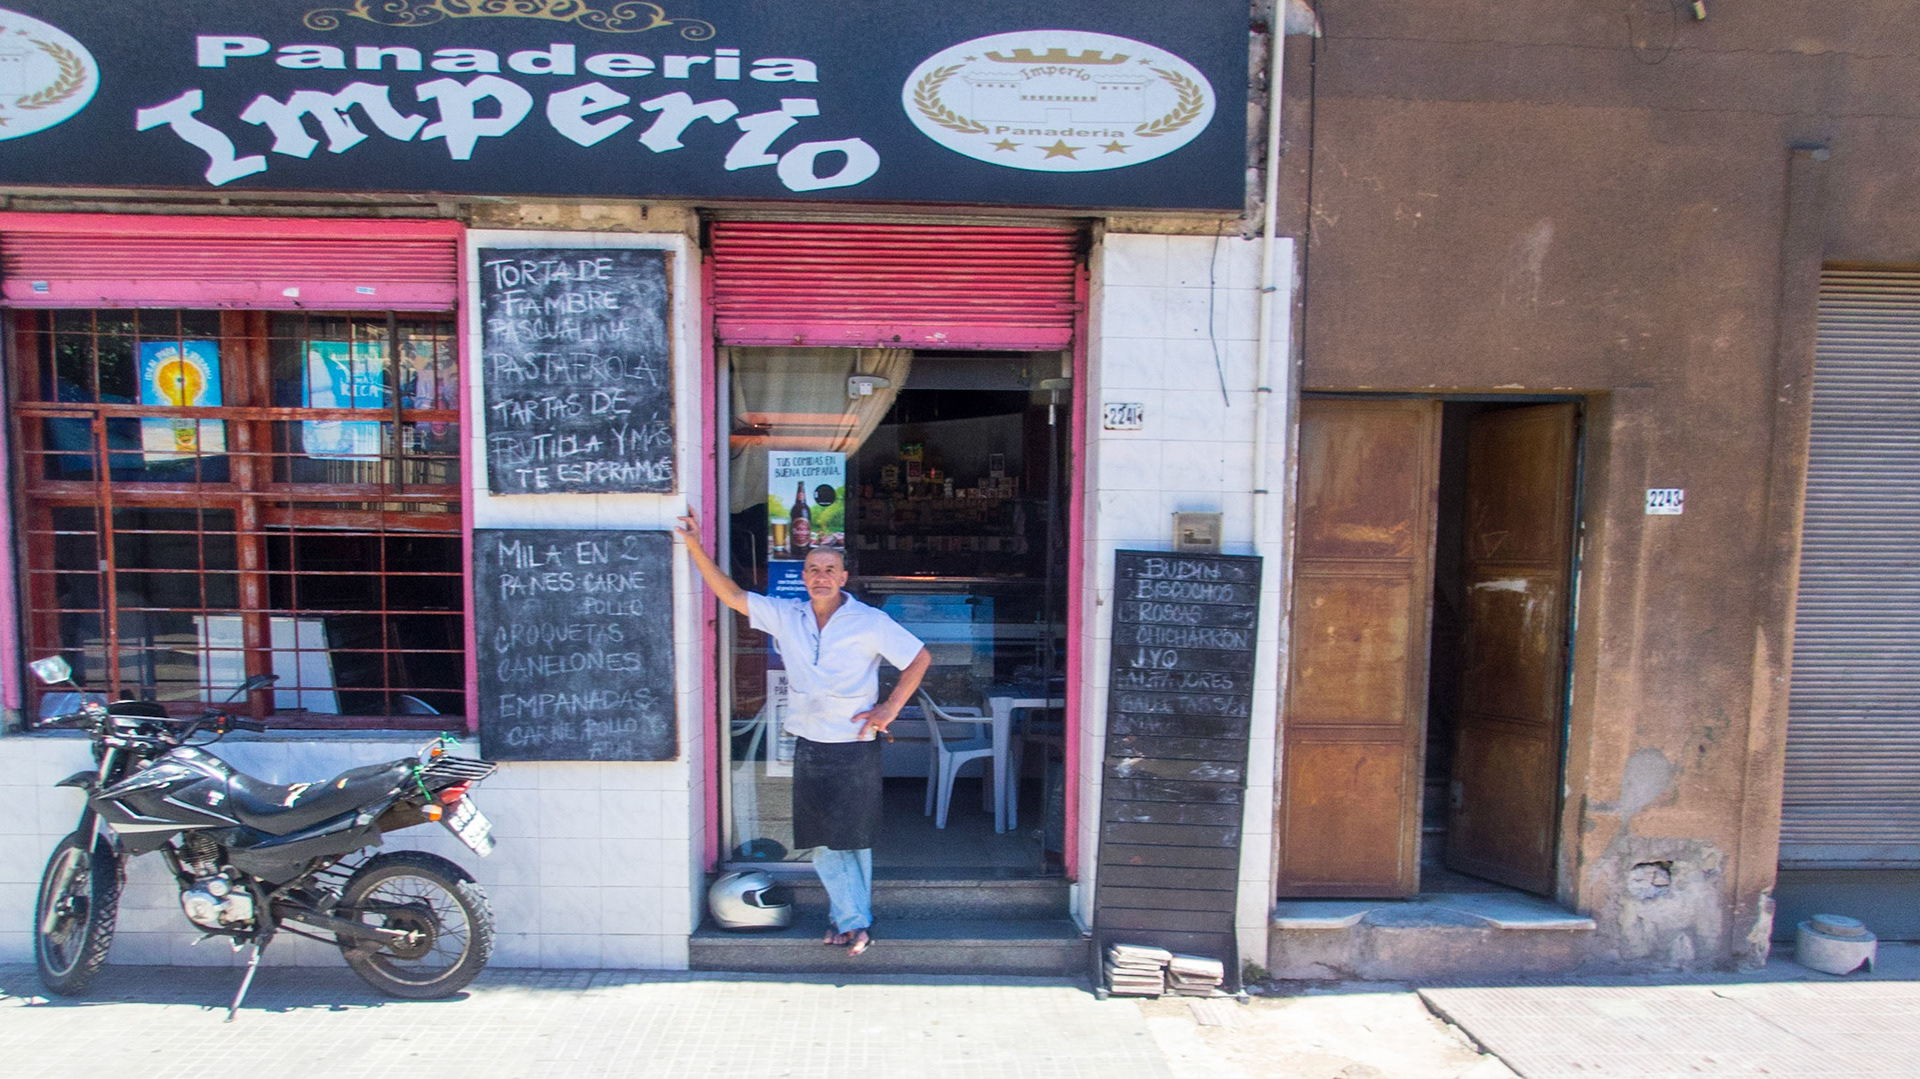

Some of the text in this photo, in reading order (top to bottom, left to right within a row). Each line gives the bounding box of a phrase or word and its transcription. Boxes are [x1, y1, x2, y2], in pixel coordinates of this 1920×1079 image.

[196, 35, 819, 83] Panaderia
[1020, 65, 1092, 81] Imperio
[137, 74, 880, 192] Imperio
[994, 126, 1125, 138] Panaderia
[576, 257, 613, 280] DE
[491, 387, 631, 427] TARTAS DE
[515, 456, 673, 489] TE ESPERAMOS
[499, 535, 639, 569] MILA EN 2
[584, 571, 646, 594] CARNE
[584, 595, 643, 616] POLLO
[494, 622, 625, 654] CROQUETAS
[497, 650, 642, 682] CANELONES
[499, 687, 653, 718] EMPANADAS
